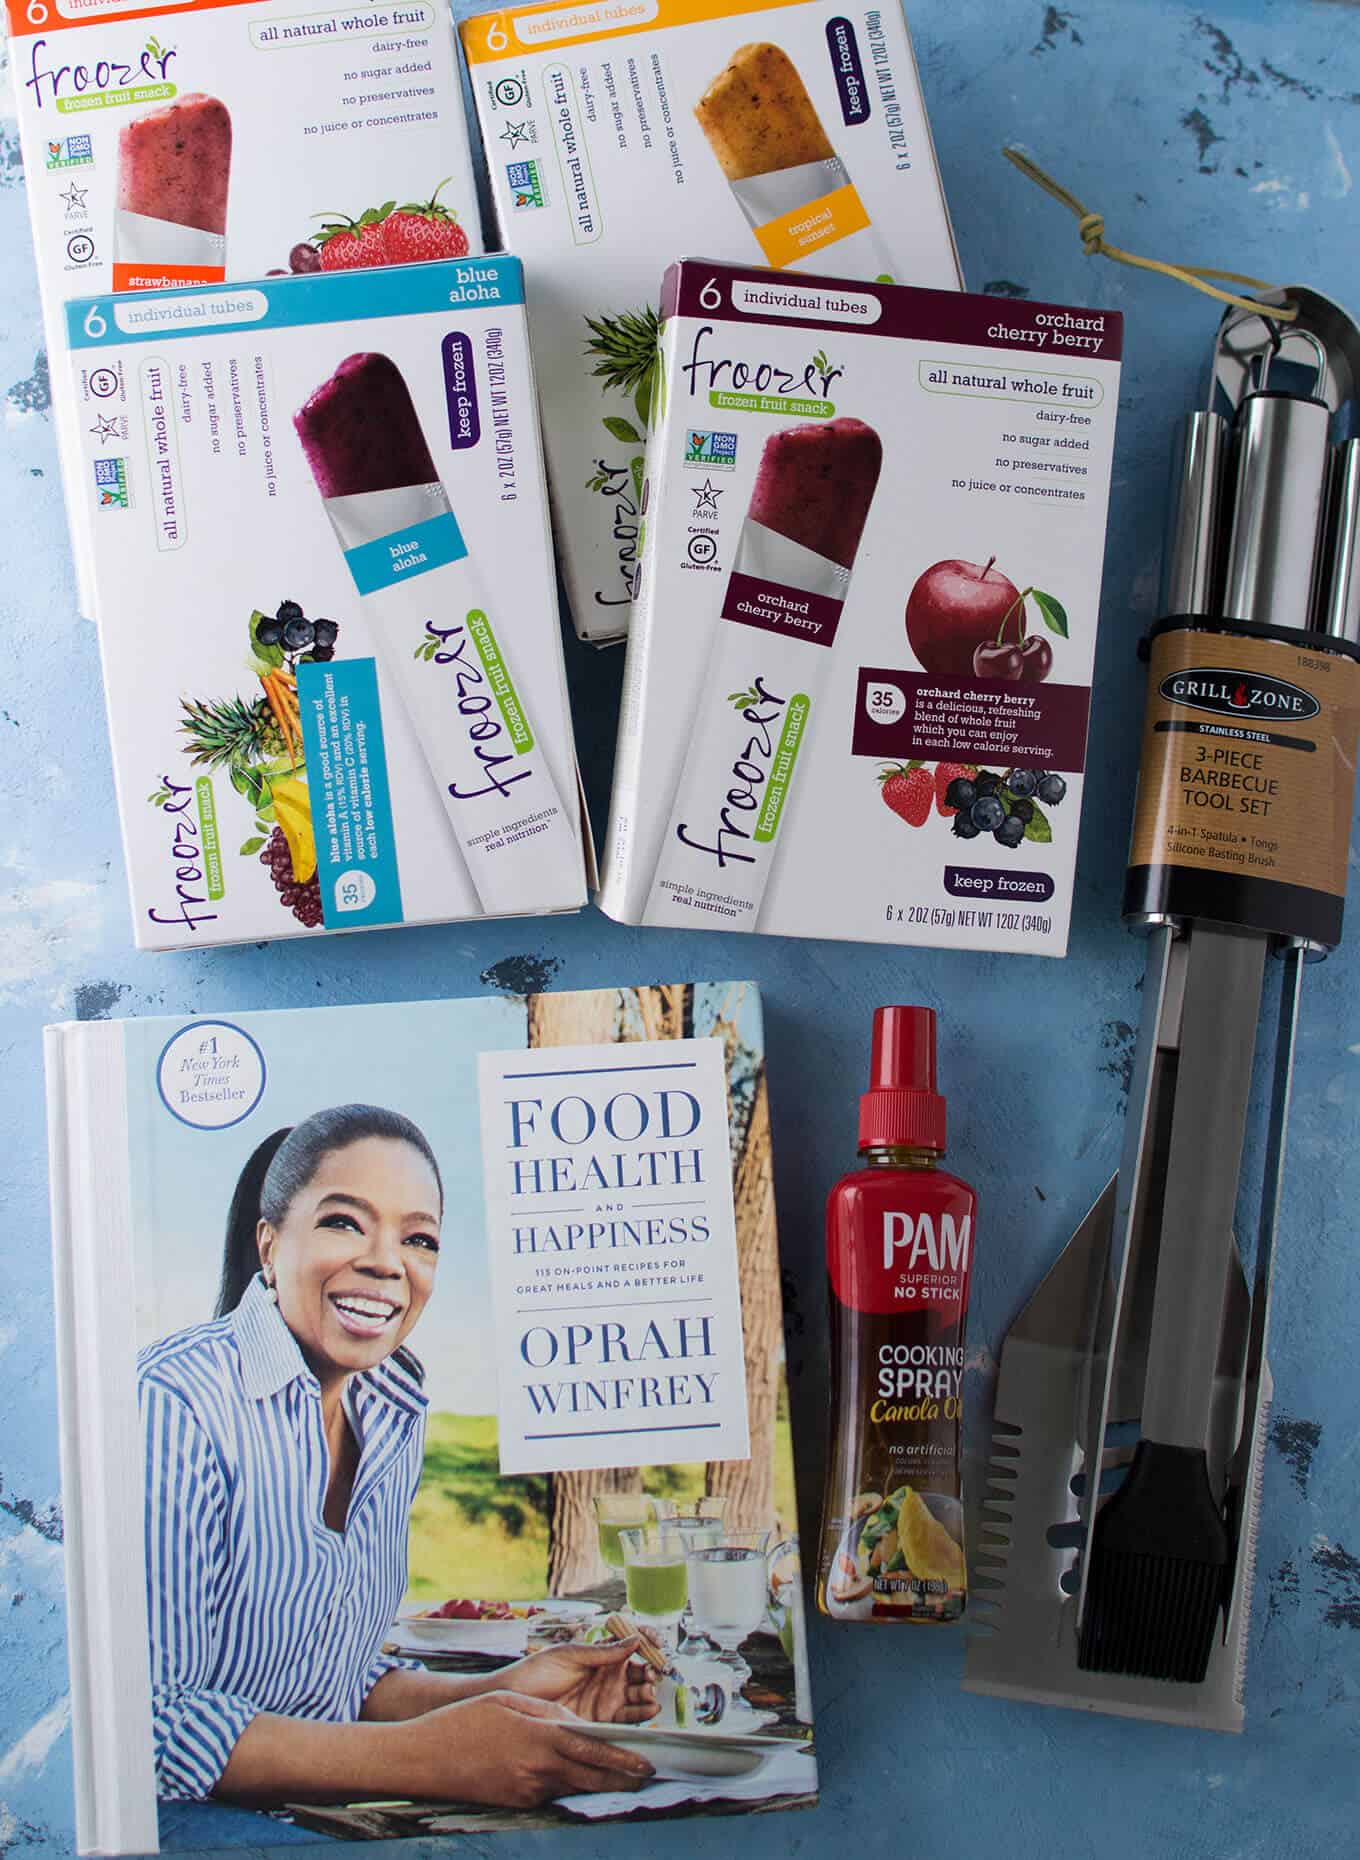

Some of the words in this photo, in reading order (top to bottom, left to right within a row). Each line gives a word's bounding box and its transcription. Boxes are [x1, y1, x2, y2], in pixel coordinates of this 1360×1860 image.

[27, 0, 49, 24] 6
[527, 13, 601, 35] individual
[604, 4, 646, 23] tubes
[260, 27, 278, 41] all
[283, 20, 337, 39] natural
[341, 14, 389, 30] whole
[392, 9, 425, 24] fruit
[487, 20, 508, 51] 6
[372, 38, 429, 53] dairy-free
[834, 25, 852, 76] frozen
[26, 37, 176, 108] froozer
[343, 71, 358, 81] no
[360, 66, 393, 80] sugar
[395, 61, 432, 75] added
[342, 95, 357, 105] no
[359, 86, 435, 106] preservatives
[550, 72, 568, 106] fruit
[848, 78, 863, 115] keep
[304, 124, 318, 135] no
[320, 119, 349, 135] juice
[351, 119, 363, 129] or
[366, 110, 438, 127] concentrates
[558, 108, 579, 155] whole
[566, 158, 591, 212] natural
[578, 214, 594, 233] all
[788, 208, 833, 237] tropical
[457, 267, 499, 284] blue
[449, 285, 501, 303] aloha
[699, 278, 721, 310] 6
[744, 289, 821, 310] individual
[825, 298, 868, 314] tubes
[84, 304, 107, 338] 6
[128, 304, 206, 324] individual
[210, 299, 255, 315] tubes
[1035, 313, 1104, 332] orchard
[987, 324, 1048, 347] cherry
[1053, 330, 1104, 352] berry
[449, 341, 467, 393] frozen
[682, 327, 843, 398] froozer
[147, 367, 163, 400] fruit
[928, 370, 948, 384] all
[952, 374, 1007, 390] natural
[1011, 377, 1058, 395] whole
[1062, 384, 1094, 400] fruit
[717, 393, 757, 408] frozen
[760, 396, 789, 410] fruit
[790, 400, 828, 415] snack
[457, 396, 472, 439] keep
[1036, 409, 1092, 425] dairy-free
[151, 405, 170, 455] whole
[713, 434, 736, 444] NON
[1002, 433, 1017, 443] no
[1019, 435, 1051, 447] sugar
[1053, 437, 1089, 450] added
[687, 453, 735, 465] VERIFIED
[713, 442, 736, 451] GMO
[995, 457, 1010, 467] no
[1012, 458, 1088, 475] preservatives
[157, 459, 176, 515] natural
[951, 478, 967, 488] no
[968, 478, 997, 492] juice
[999, 483, 1012, 493] or
[1014, 484, 1086, 501] concentrates
[692, 510, 719, 520] PARVE
[164, 520, 178, 539] all
[687, 526, 720, 536] Certified
[390, 539, 420, 558] blue
[693, 544, 711, 556] GF
[392, 553, 428, 573] aloha
[757, 591, 809, 615] orchard
[736, 600, 783, 624] cherry
[784, 611, 823, 634] berry
[470, 616, 496, 662] snack
[488, 662, 509, 696] fruit
[872, 690, 893, 708] 35
[916, 687, 961, 700] orchard
[963, 691, 1001, 705] cherry
[1003, 694, 1036, 708] berry
[1172, 680, 1231, 700] GRILL
[1251, 689, 1303, 712] ZONE
[425, 620, 532, 799] froozer
[503, 696, 528, 745] frozen
[914, 711, 945, 723] blend
[947, 714, 959, 724] of
[960, 715, 992, 727] whole
[994, 717, 1016, 729] fruit
[915, 699, 925, 709] is
[926, 702, 933, 710] a
[936, 701, 986, 715] delicious,
[988, 706, 1042, 721] refreshing
[913, 724, 945, 736] which
[947, 728, 966, 739] you
[968, 730, 987, 739] can
[990, 730, 1018, 743] enjoy
[1199, 724, 1245, 739] STAINLESS
[1246, 731, 1271, 743] STEEL
[912, 736, 923, 745] in
[925, 737, 950, 748] each
[952, 739, 971, 750] low
[973, 741, 1010, 753] calorie
[1012, 745, 1054, 758] serving.
[1196, 746, 1264, 771] 3-PIECE
[676, 676, 786, 868] froozer
[758, 787, 784, 833] frozen
[771, 751, 792, 783] fruit
[785, 702, 806, 748] snack
[1180, 767, 1280, 795] BARBECUE
[1183, 789, 1234, 811] TOOL
[1240, 798, 1273, 816] SET
[1167, 824, 1196, 838] 4-in-1
[1200, 827, 1238, 844] Spatula
[1251, 835, 1279, 851] Tongs
[148, 775, 218, 930] froozer
[1168, 842, 1206, 856] Silicone
[1208, 847, 1246, 865] Basting
[1248, 854, 1276, 867] Brush
[659, 879, 694, 896] simple
[696, 887, 755, 911] ingredients
[954, 873, 994, 893] keep
[997, 876, 1046, 894] frozen
[671, 893, 693, 906] real
[693, 899, 738, 918] nutrition
[199, 1036, 218, 1055] #1
[180, 1057, 210, 1072] New
[211, 1055, 240, 1070] York
[194, 1073, 231, 1088] Times
[180, 1088, 246, 1103] Bestseller
[504, 1090, 702, 1149] FOOD
[508, 1148, 707, 1195] HEALTH
[595, 1203, 625, 1213] AND
[512, 1215, 711, 1255] HAPPINESS
[882, 1211, 971, 1273] PAM
[554, 1264, 610, 1276] ON-POINT
[613, 1261, 660, 1272] RECIPES
[663, 1259, 687, 1269] FOR
[900, 1273, 958, 1285] SUPERIOR
[516, 1284, 553, 1295] GREAT
[556, 1281, 594, 1291] MEALS
[597, 1280, 620, 1290] AND
[623, 1278, 632, 1288] A
[634, 1276, 677, 1287] BETTER
[680, 1274, 706, 1284] LIFE
[894, 1287, 917, 1298] NO
[921, 1287, 960, 1300] STICK
[520, 1313, 717, 1368] OPRAH
[879, 1345, 963, 1366] COOKING
[523, 1372, 720, 1415] WINFREY
[878, 1368, 963, 1399] SPRAY
[870, 1397, 939, 1423] Canola
[888, 1445, 904, 1455] no
